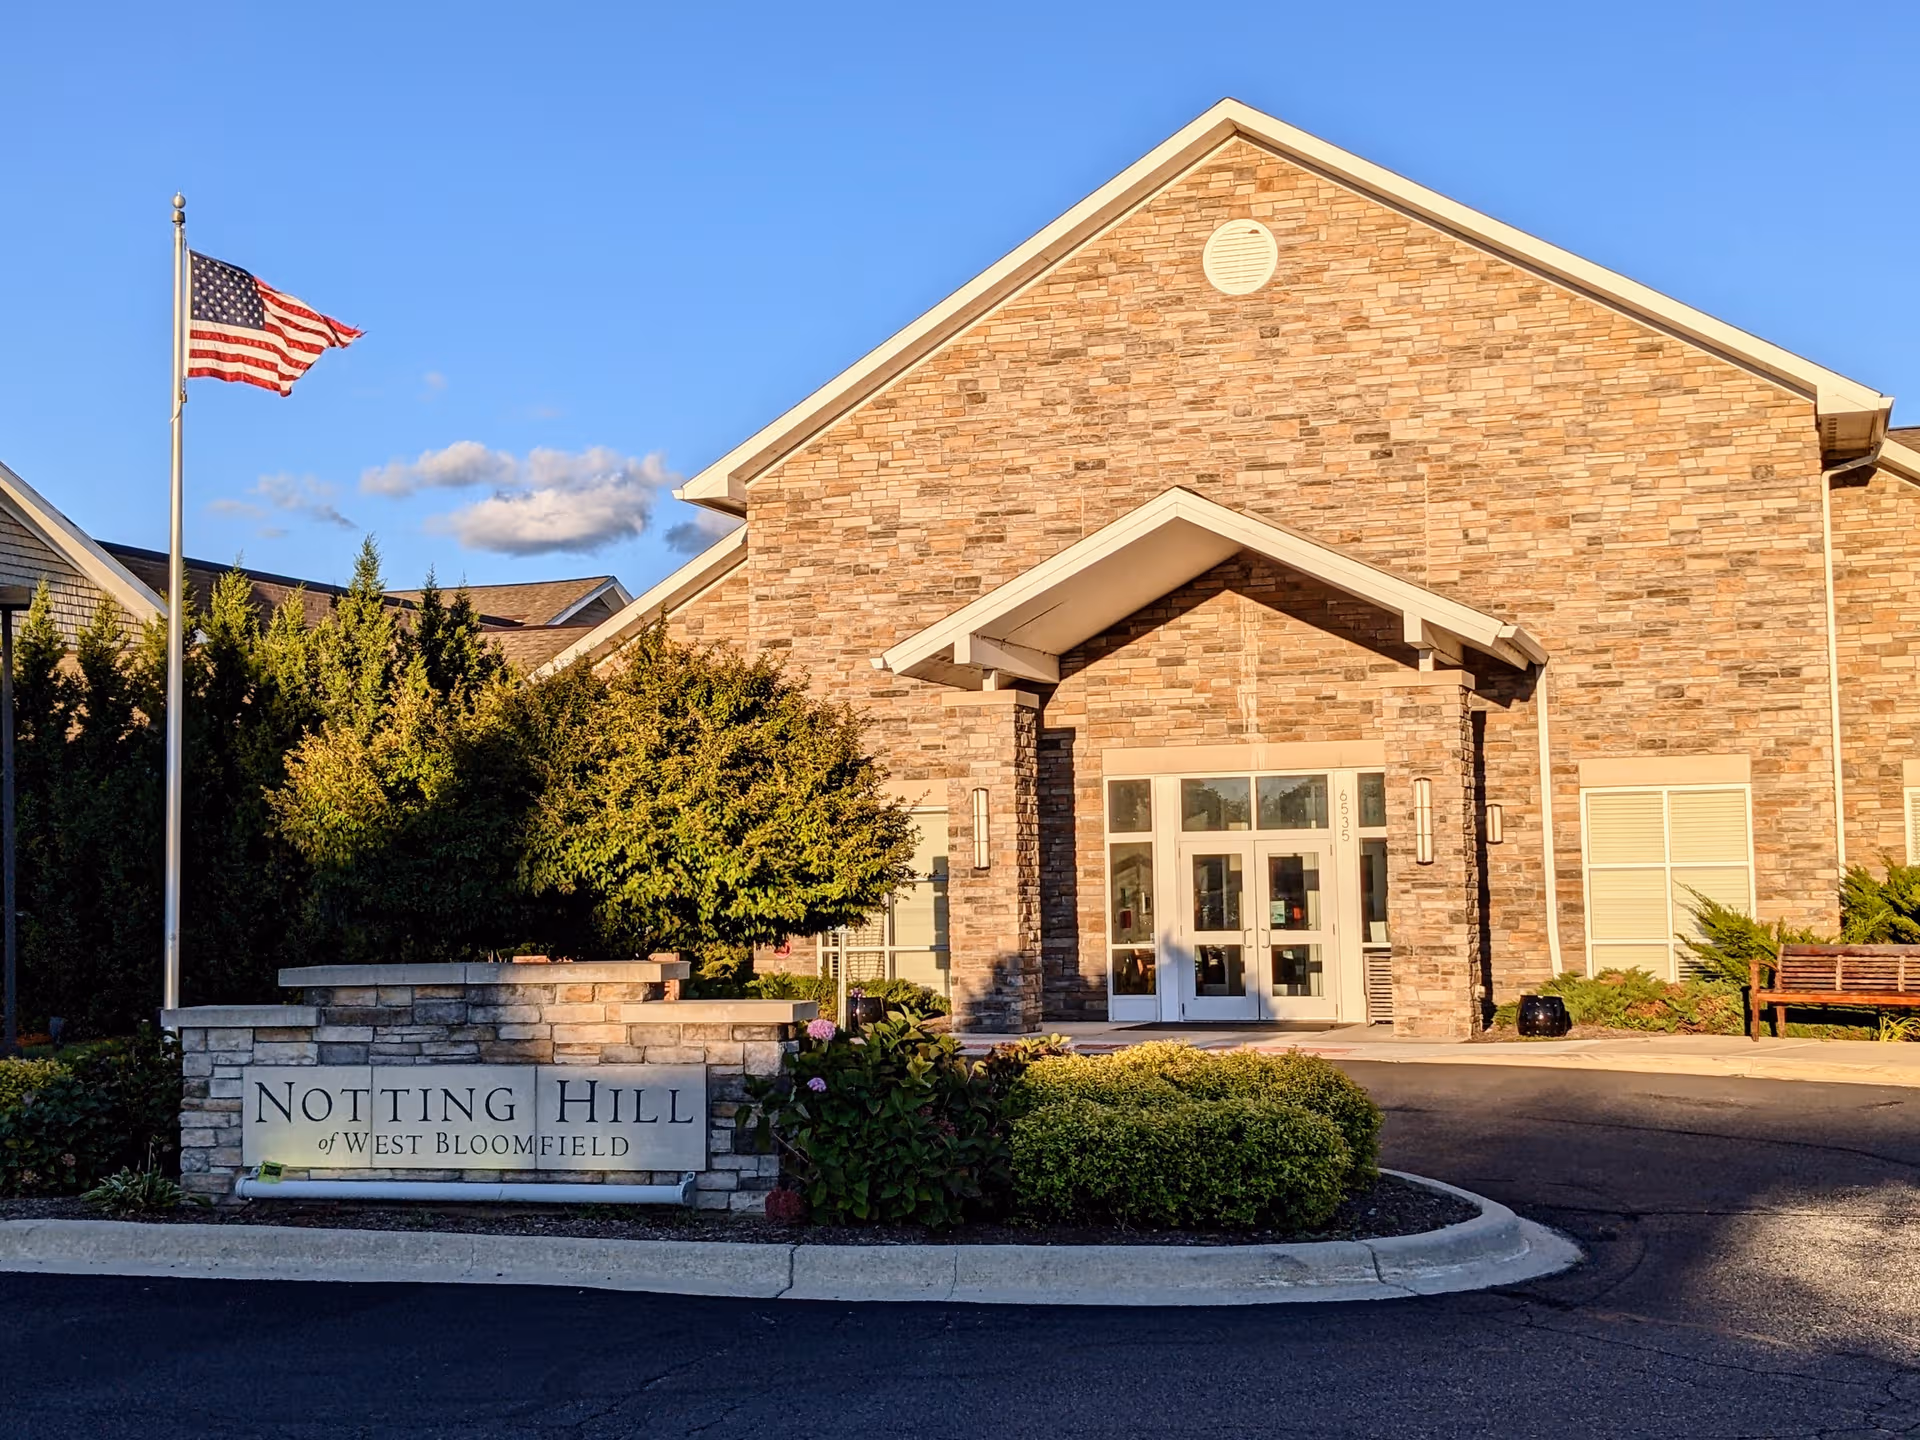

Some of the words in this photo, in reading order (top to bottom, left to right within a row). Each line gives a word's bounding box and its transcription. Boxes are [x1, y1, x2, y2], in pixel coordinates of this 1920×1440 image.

[1339, 789, 1350, 842] 6535
[255, 1081, 516, 1123] NOTTING
[556, 1080, 694, 1124] HILL
[318, 1132, 339, 1155] of
[343, 1132, 423, 1155] WEST
[435, 1132, 629, 1157] BLOOMFIELD
